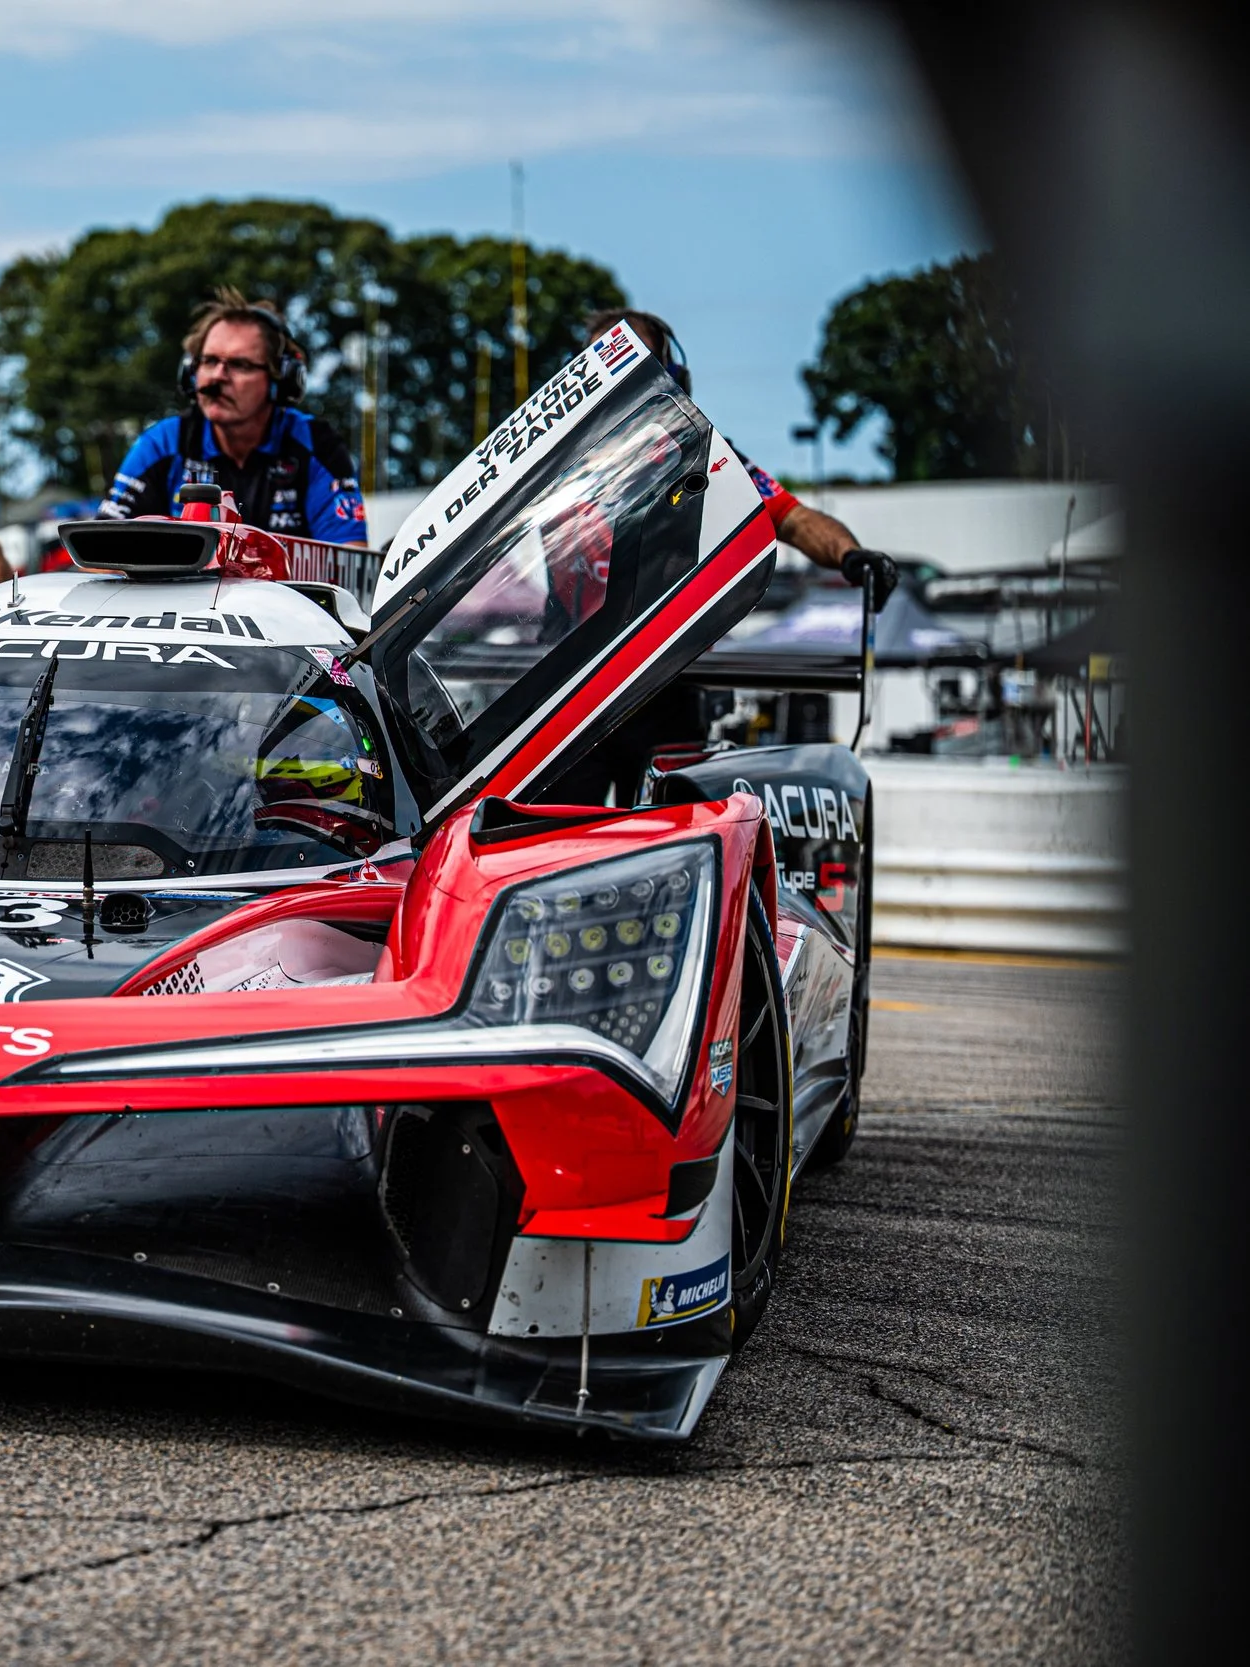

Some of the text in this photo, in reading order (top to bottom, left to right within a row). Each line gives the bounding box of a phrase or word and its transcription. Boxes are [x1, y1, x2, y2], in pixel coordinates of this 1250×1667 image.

[475, 352, 589, 457] VAUTIER
[477, 364, 590, 468] YELLOLY
[383, 525, 437, 582] VAN
[444, 464, 500, 524] DER
[507, 371, 604, 464] ZANDE
[330, 674, 355, 688] 2025
[764, 784, 859, 843] ACURA
[776, 862, 847, 912] Type S
[677, 1270, 728, 1306] MICHELIN
